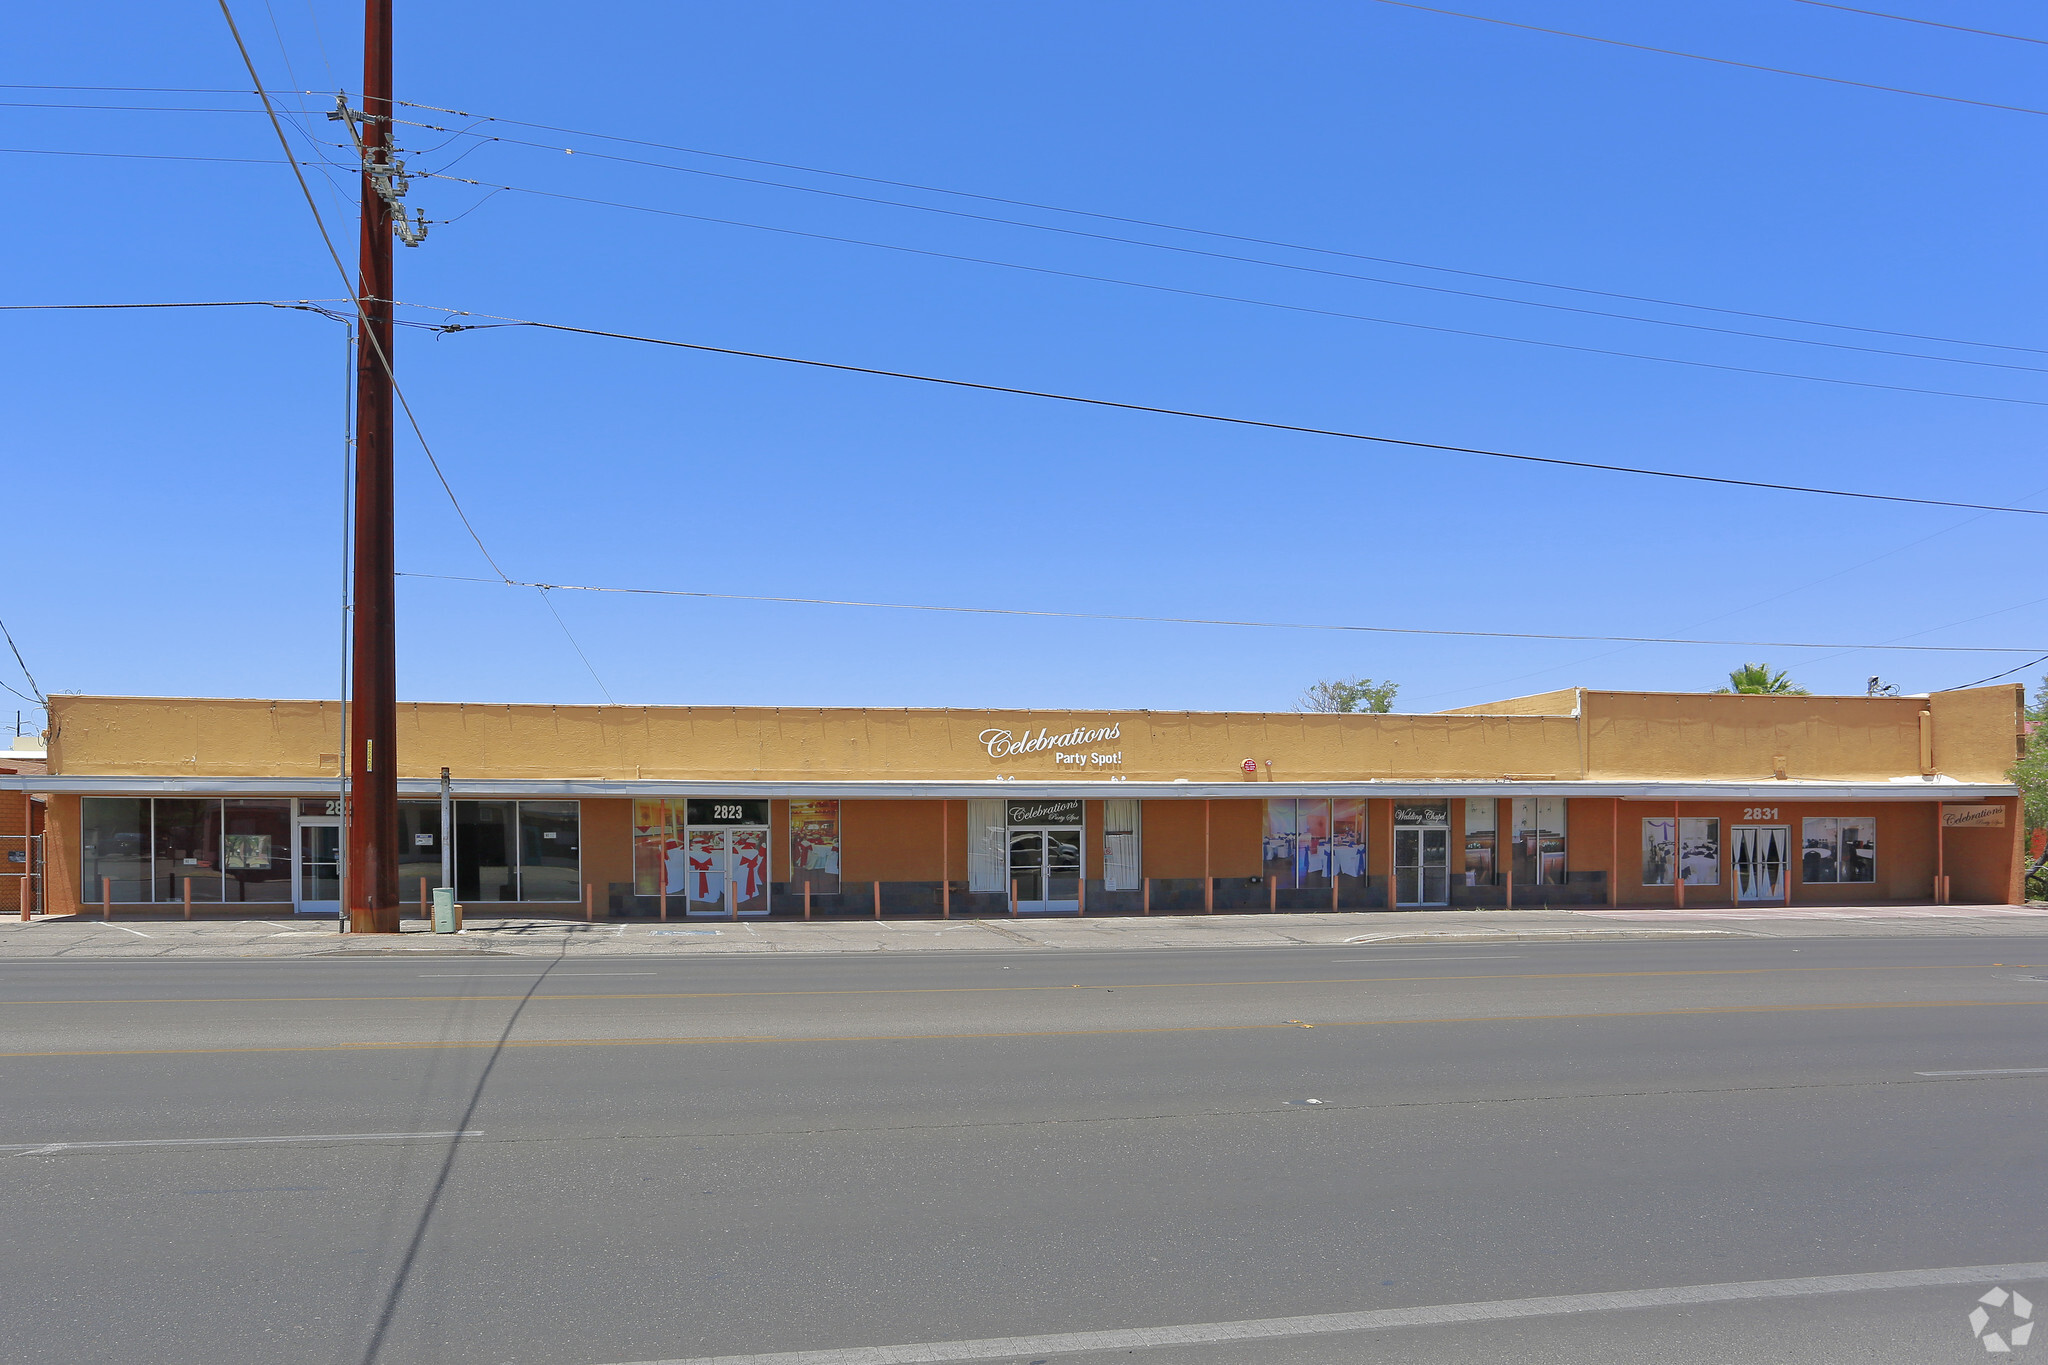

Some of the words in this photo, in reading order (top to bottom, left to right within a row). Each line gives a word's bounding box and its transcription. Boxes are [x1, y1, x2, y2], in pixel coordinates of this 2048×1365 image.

[979, 722, 1121, 758] Celebrations
[1055, 752, 1087, 766] Party
[1091, 751, 1122, 766] Spot!
[714, 805, 742, 819] 2823
[1008, 800, 1078, 822] Celebrations
[1048, 813, 1065, 823] Party
[1395, 808, 1423, 824] Wedding
[1424, 809, 1446, 823] Chapel
[1743, 808, 1778, 820] 2831
[1943, 806, 2003, 826] Celebrations
